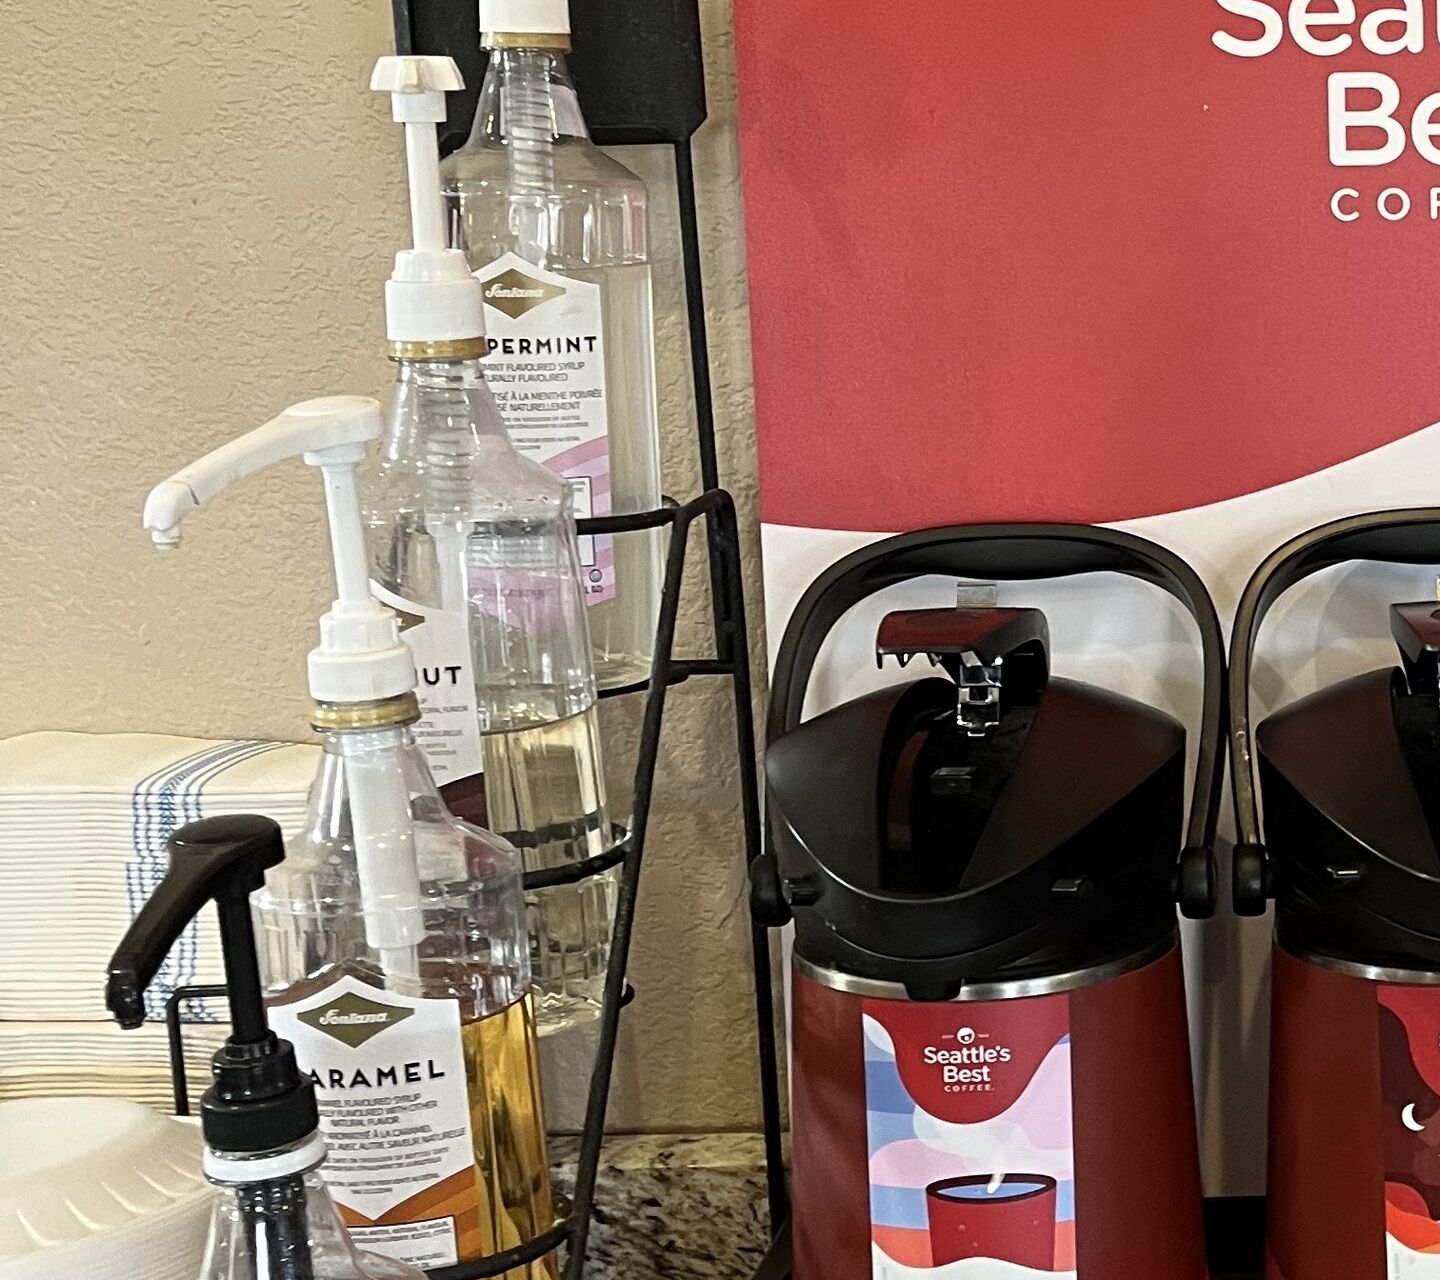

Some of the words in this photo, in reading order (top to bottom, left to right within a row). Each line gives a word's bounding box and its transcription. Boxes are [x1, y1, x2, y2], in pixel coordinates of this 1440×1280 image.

[486, 336, 597, 355] PERMINT
[923, 1044, 1012, 1066] Seattle's
[310, 1060, 445, 1089] ARAMEL
[943, 1065, 992, 1084] Best
